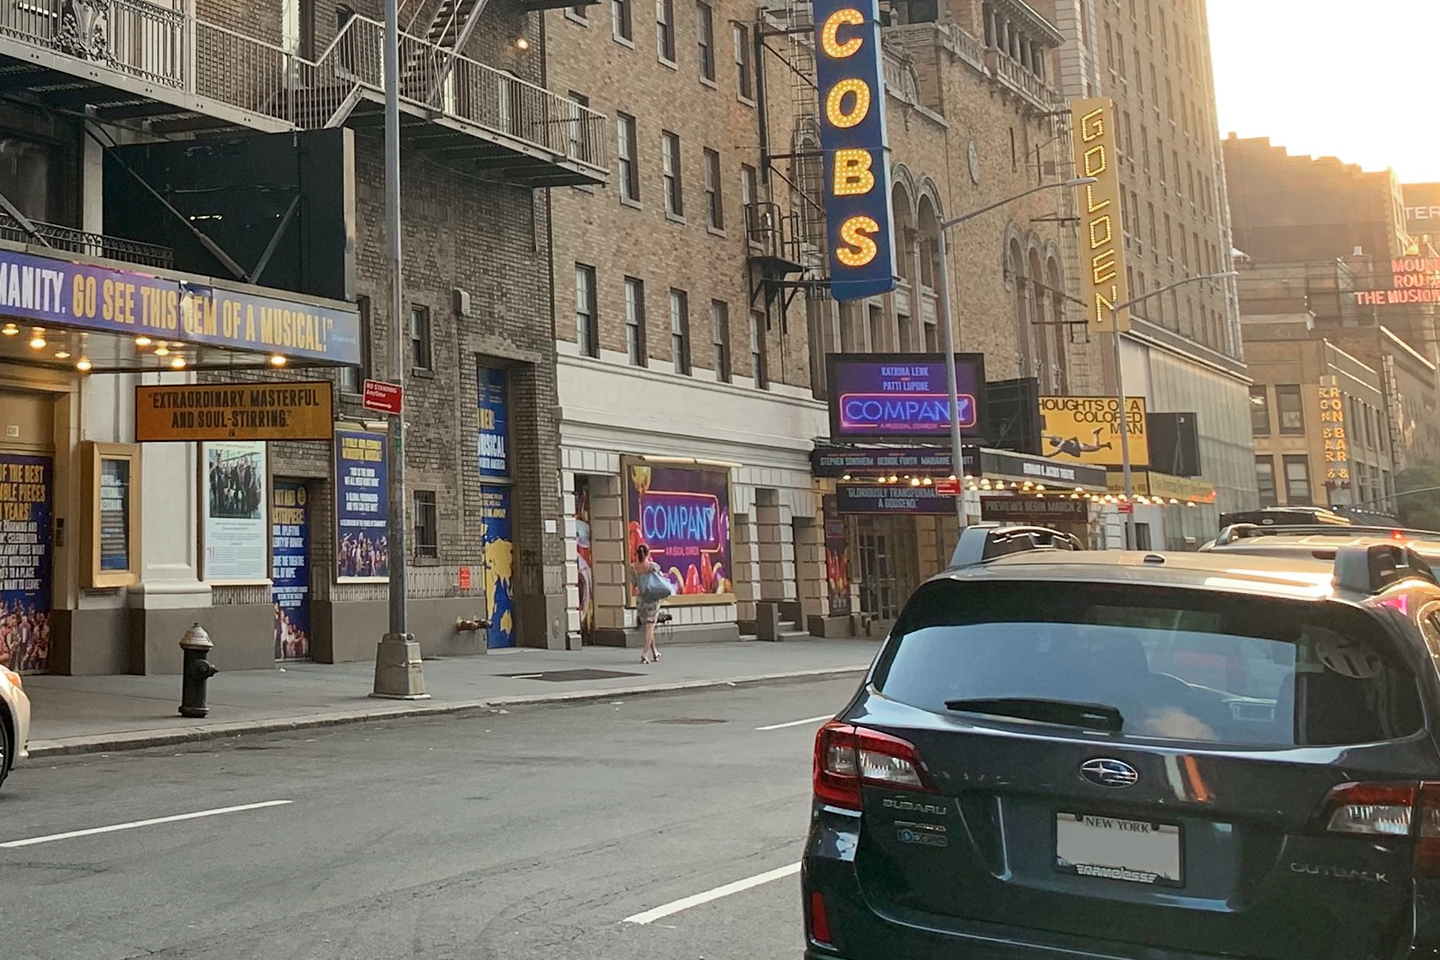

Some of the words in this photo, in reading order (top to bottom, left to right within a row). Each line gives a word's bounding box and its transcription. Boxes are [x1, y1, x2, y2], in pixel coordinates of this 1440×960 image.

[1080, 107, 1117, 322] GOLDEN
[1354, 291, 1386, 305] THE
[73, 275, 97, 319] GO
[102, 279, 136, 324] SEE
[140, 284, 177, 331] THIS
[222, 302, 242, 340] OF
[245, 304, 256, 342] A
[881, 367, 911, 377] KATRINA
[912, 367, 930, 377] LENK
[883, 381, 902, 391] PATTI
[903, 381, 930, 391] LUPONE
[250, 388, 319, 408] MASTERFUL
[1130, 399, 1142, 411] A
[1330, 375, 1344, 423] IRON
[171, 410, 194, 429] AND
[1334, 427, 1347, 462] BAR
[820, 456, 844, 466] STEPHEN
[845, 456, 873, 466] SONDHEIM
[877, 456, 898, 466] GEORGE
[899, 456, 917, 466] FURTH
[921, 456, 950, 466] MARIANNE
[9, 464, 23, 482] THE
[25, 465, 44, 483] BEST
[19, 484, 46, 502] PIECES
[878, 499, 884, 508] A
[986, 501, 1023, 512] PREVIEWS
[1025, 501, 1046, 511] BEGIN
[1048, 501, 1074, 512] MARCH
[1076, 502, 1082, 512] 2
[643, 503, 716, 541] COMPANY
[883, 799, 947, 815] SUBARU
[1085, 816, 1114, 829] NEW
[1116, 820, 1151, 834] YORK
[1079, 865, 1155, 883] nameless
